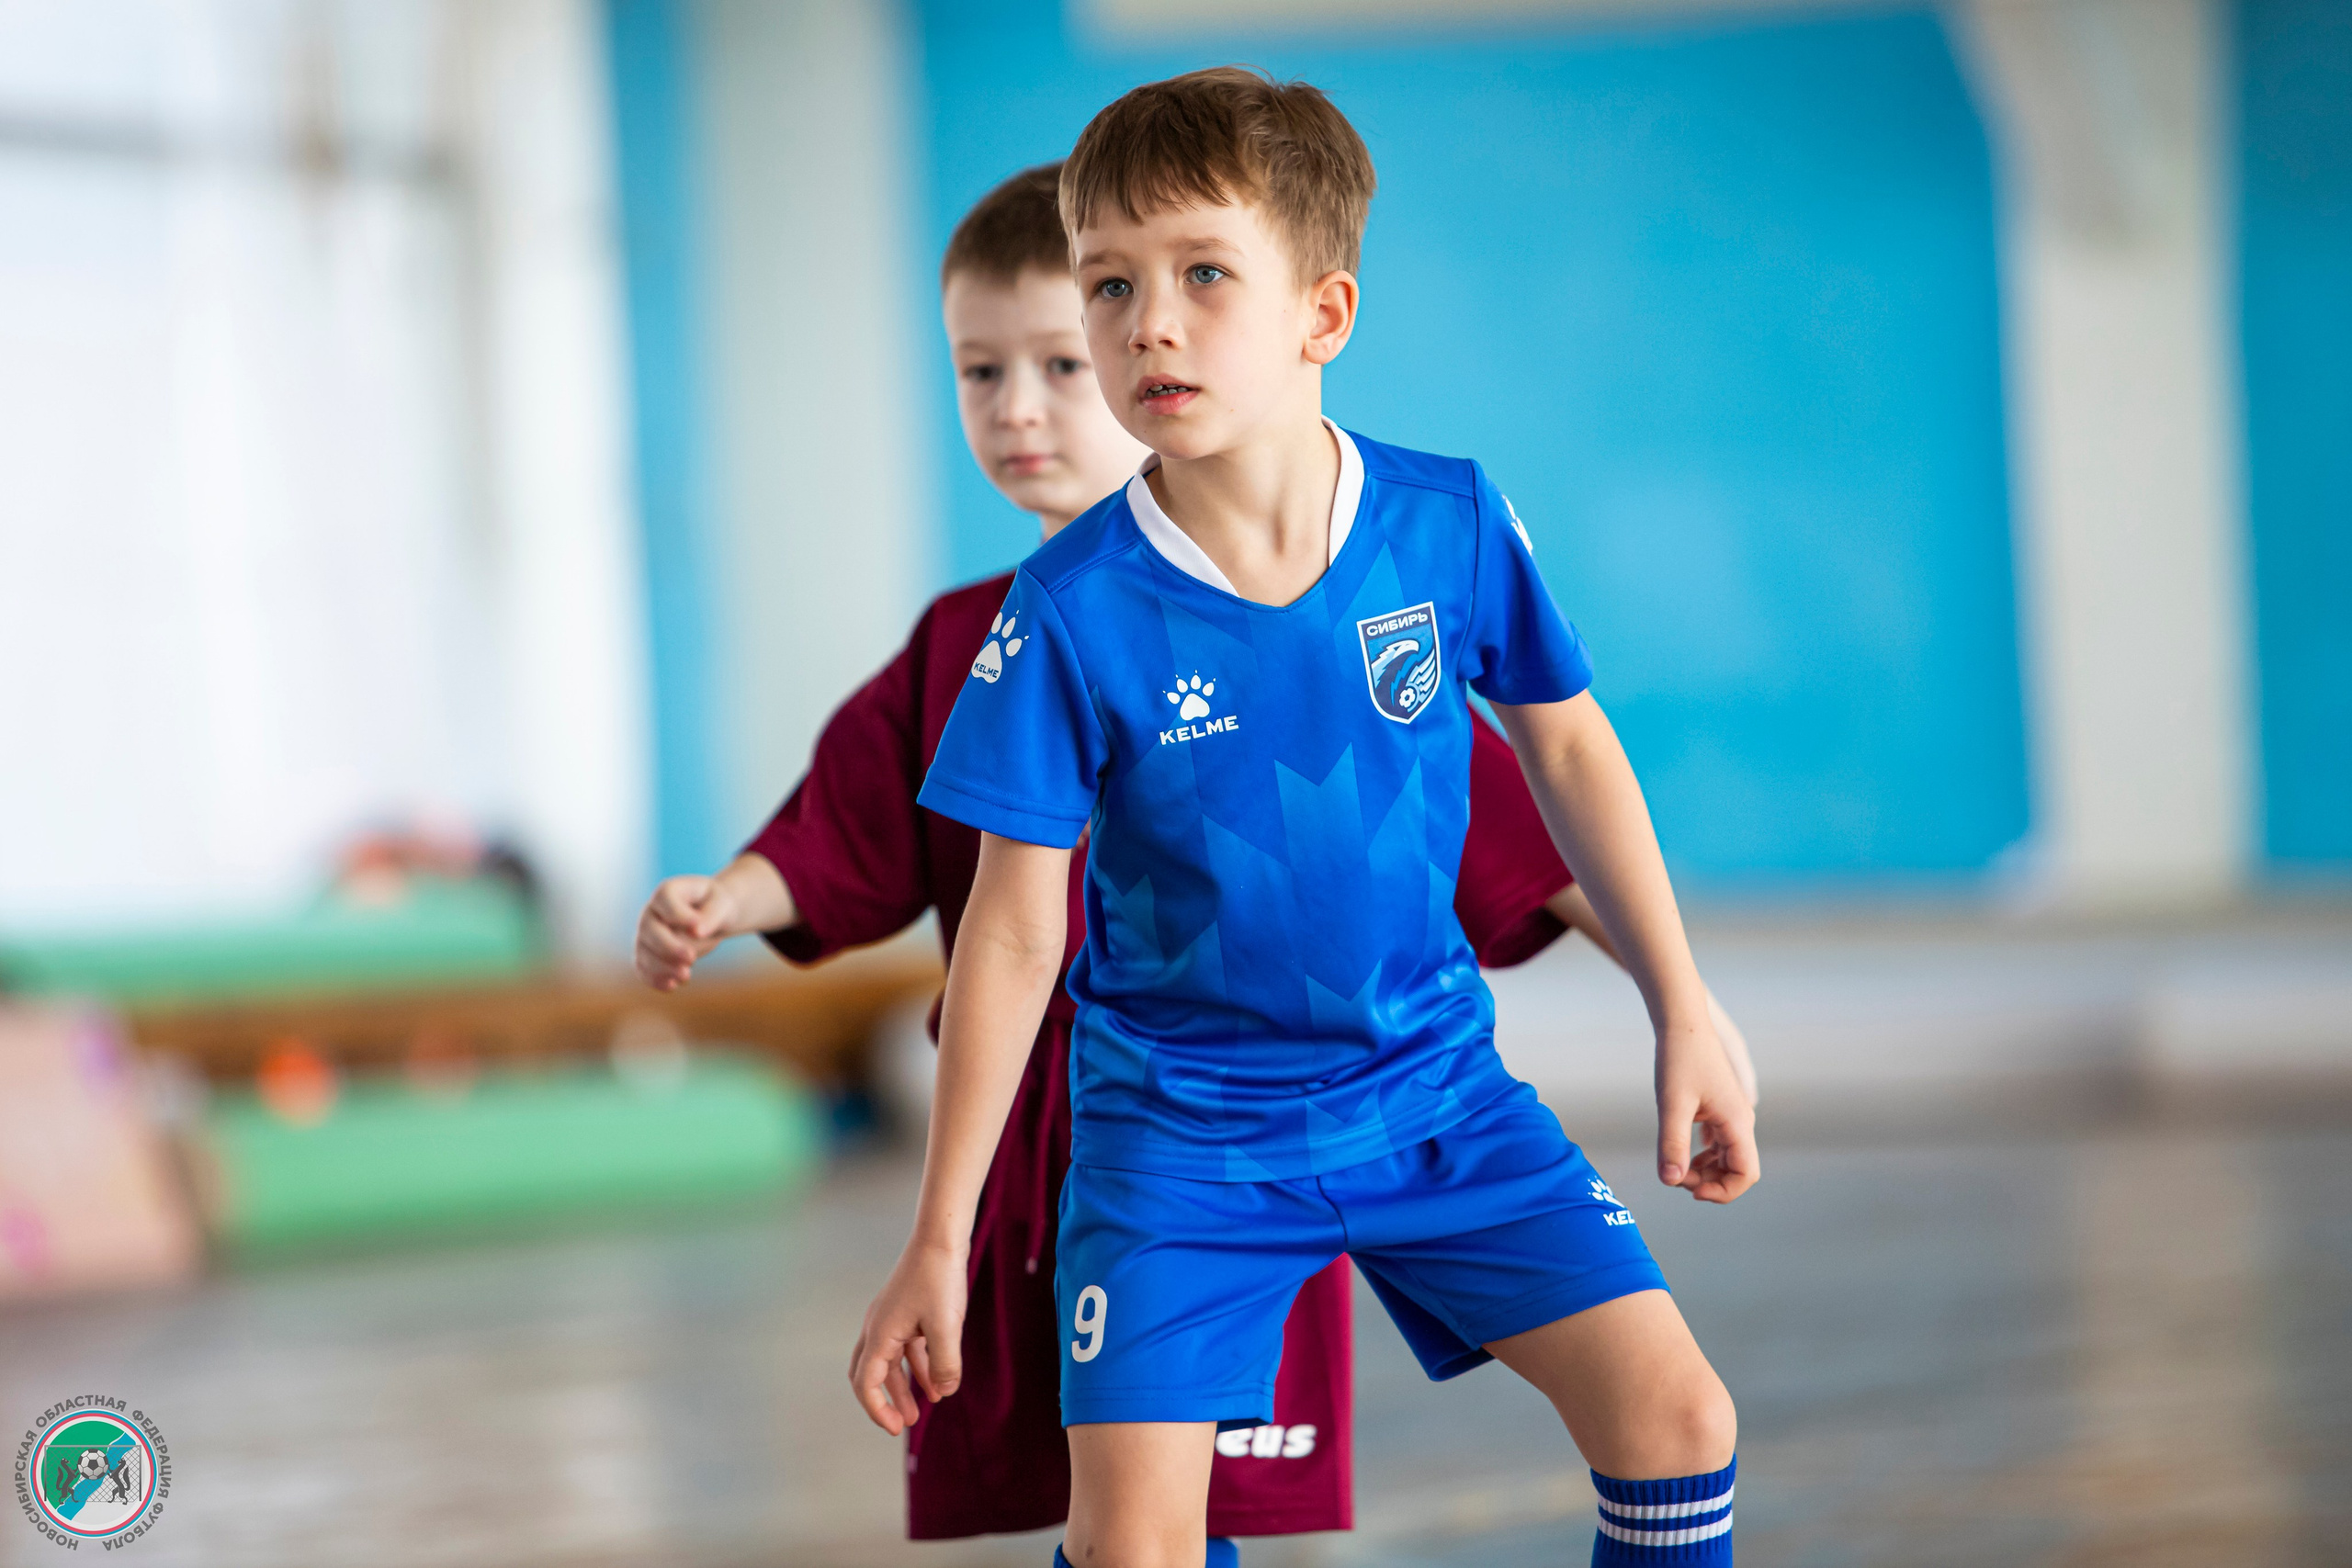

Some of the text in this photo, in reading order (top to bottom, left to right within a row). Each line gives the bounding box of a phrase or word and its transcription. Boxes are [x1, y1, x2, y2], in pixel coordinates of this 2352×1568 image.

[1366, 612, 1429, 637] СИБИРЬ
[974, 662, 1000, 678] KELME
[1159, 715, 1239, 745] KELME
[1071, 1284, 1108, 1363] 9
